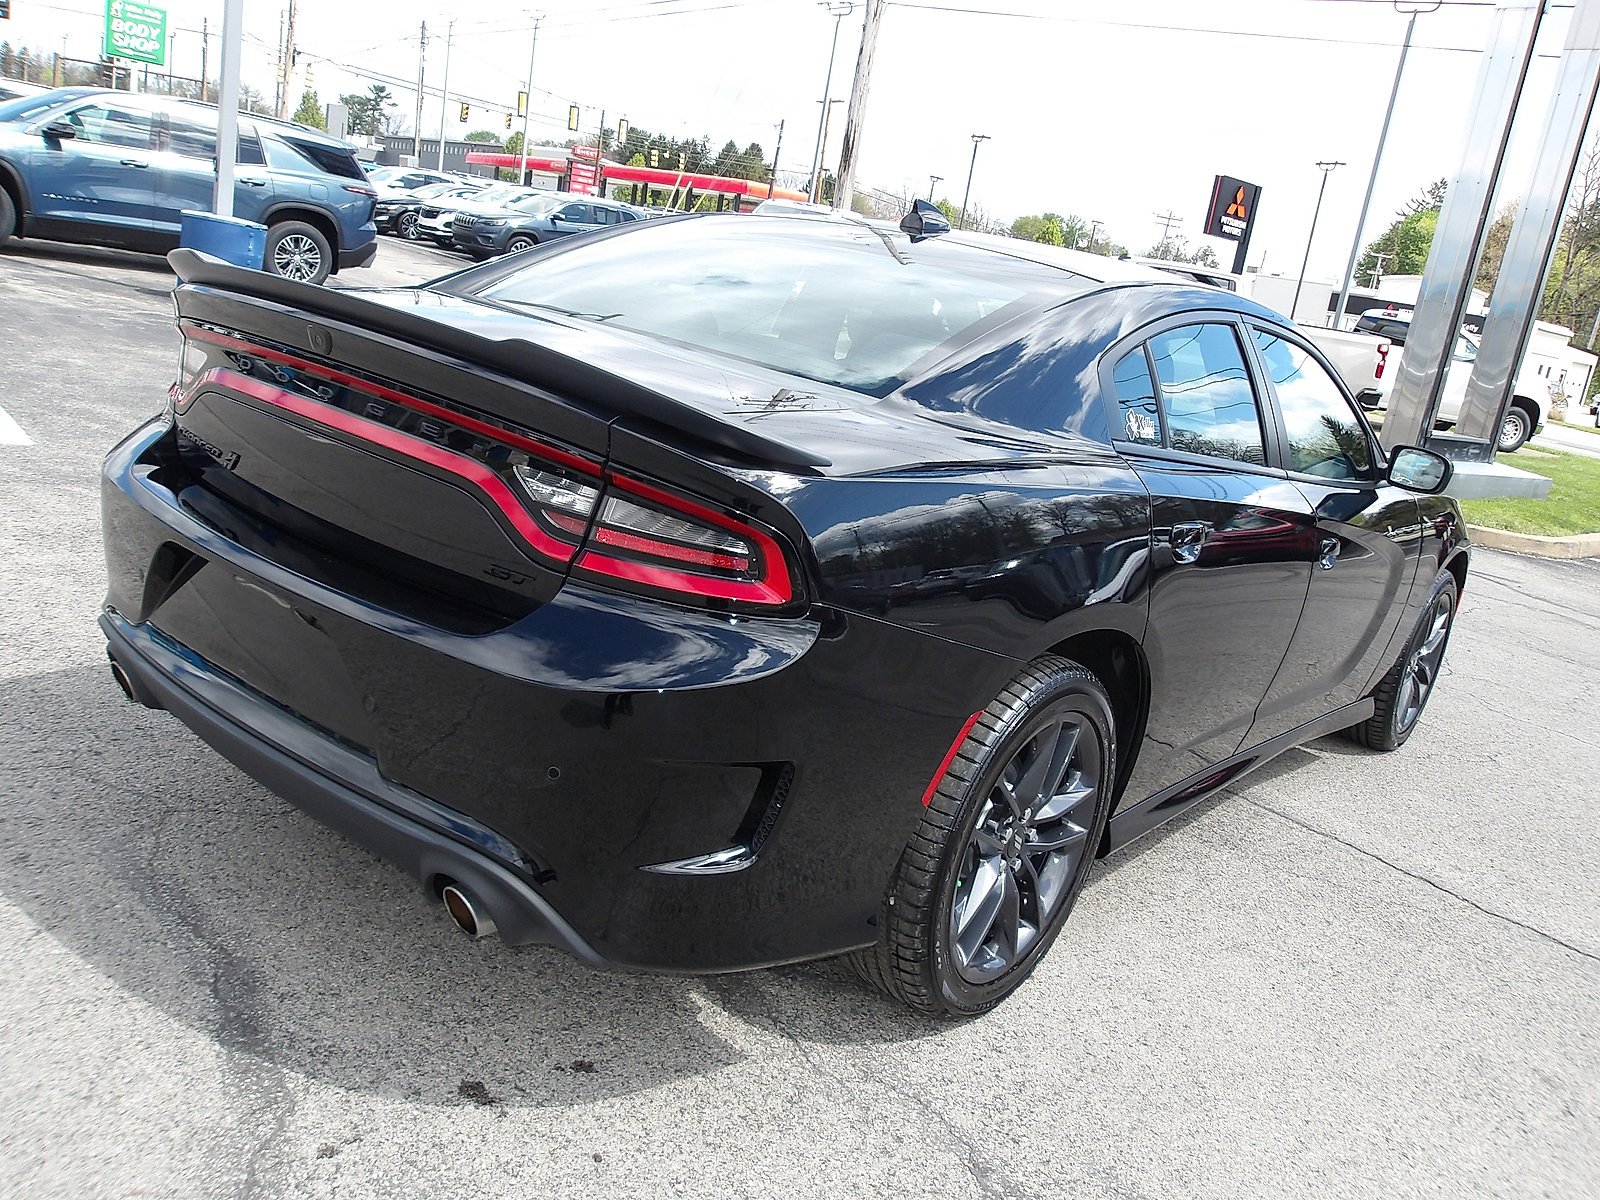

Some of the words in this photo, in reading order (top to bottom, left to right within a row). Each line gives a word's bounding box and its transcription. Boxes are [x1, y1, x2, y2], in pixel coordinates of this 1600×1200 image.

[111, 18, 161, 39] BODY
[111, 32, 160, 52] SHOP
[1222, 225, 1242, 236] MOTORS
[236, 356, 444, 439] DODGE
